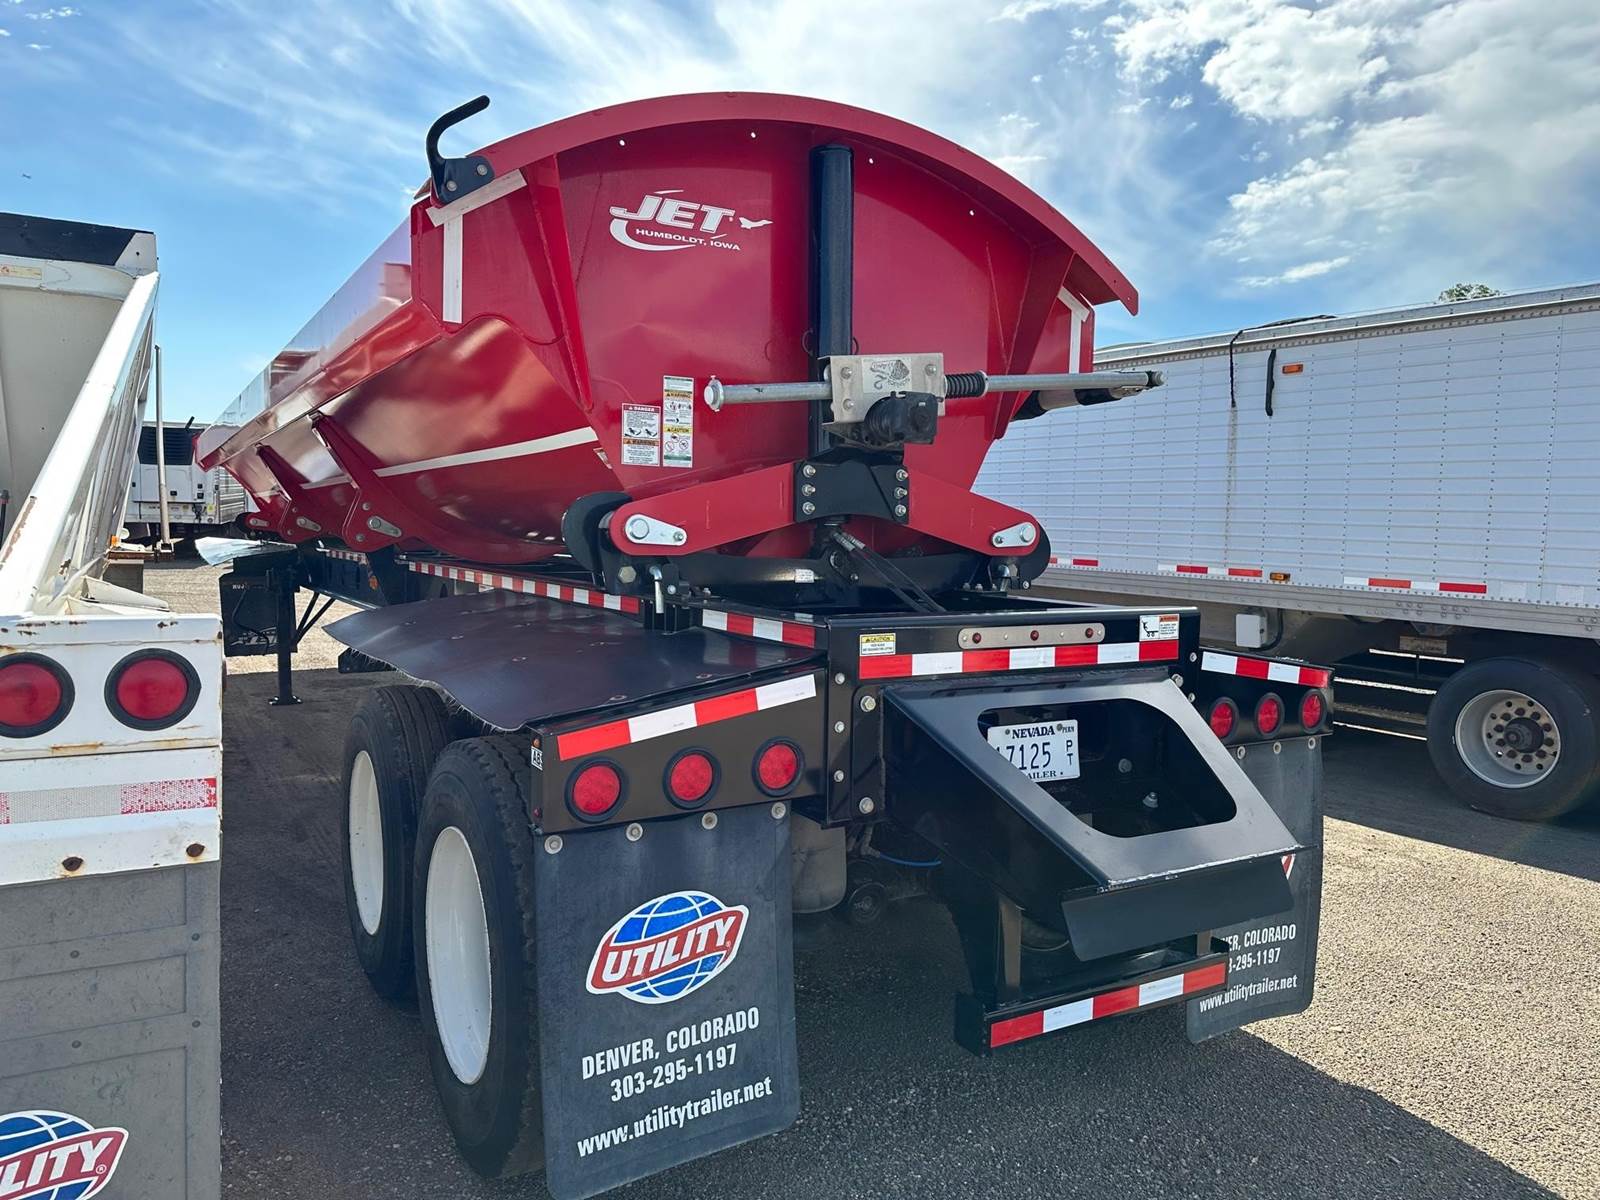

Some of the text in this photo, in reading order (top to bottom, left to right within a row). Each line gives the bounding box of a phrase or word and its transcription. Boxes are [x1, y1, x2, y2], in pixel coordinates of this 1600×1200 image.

[609, 194, 736, 234] JET
[636, 228, 741, 251] HUMBOLDT, IOWA
[1012, 725, 1055, 739] NEVADA
[997, 742, 1052, 770] 7125
[1028, 770, 1056, 780] AILER
[602, 916, 736, 982] UTILITY
[1244, 924, 1296, 947] COLORADO
[1229, 947, 1280, 973] 3-295-1197
[1200, 974, 1297, 1012] www.utilitytrailer.net
[582, 1006, 760, 1080] DENVER, COLORADO
[610, 1043, 738, 1102] 303-295-1197
[577, 1076, 773, 1158] www.utilitytrailer.net
